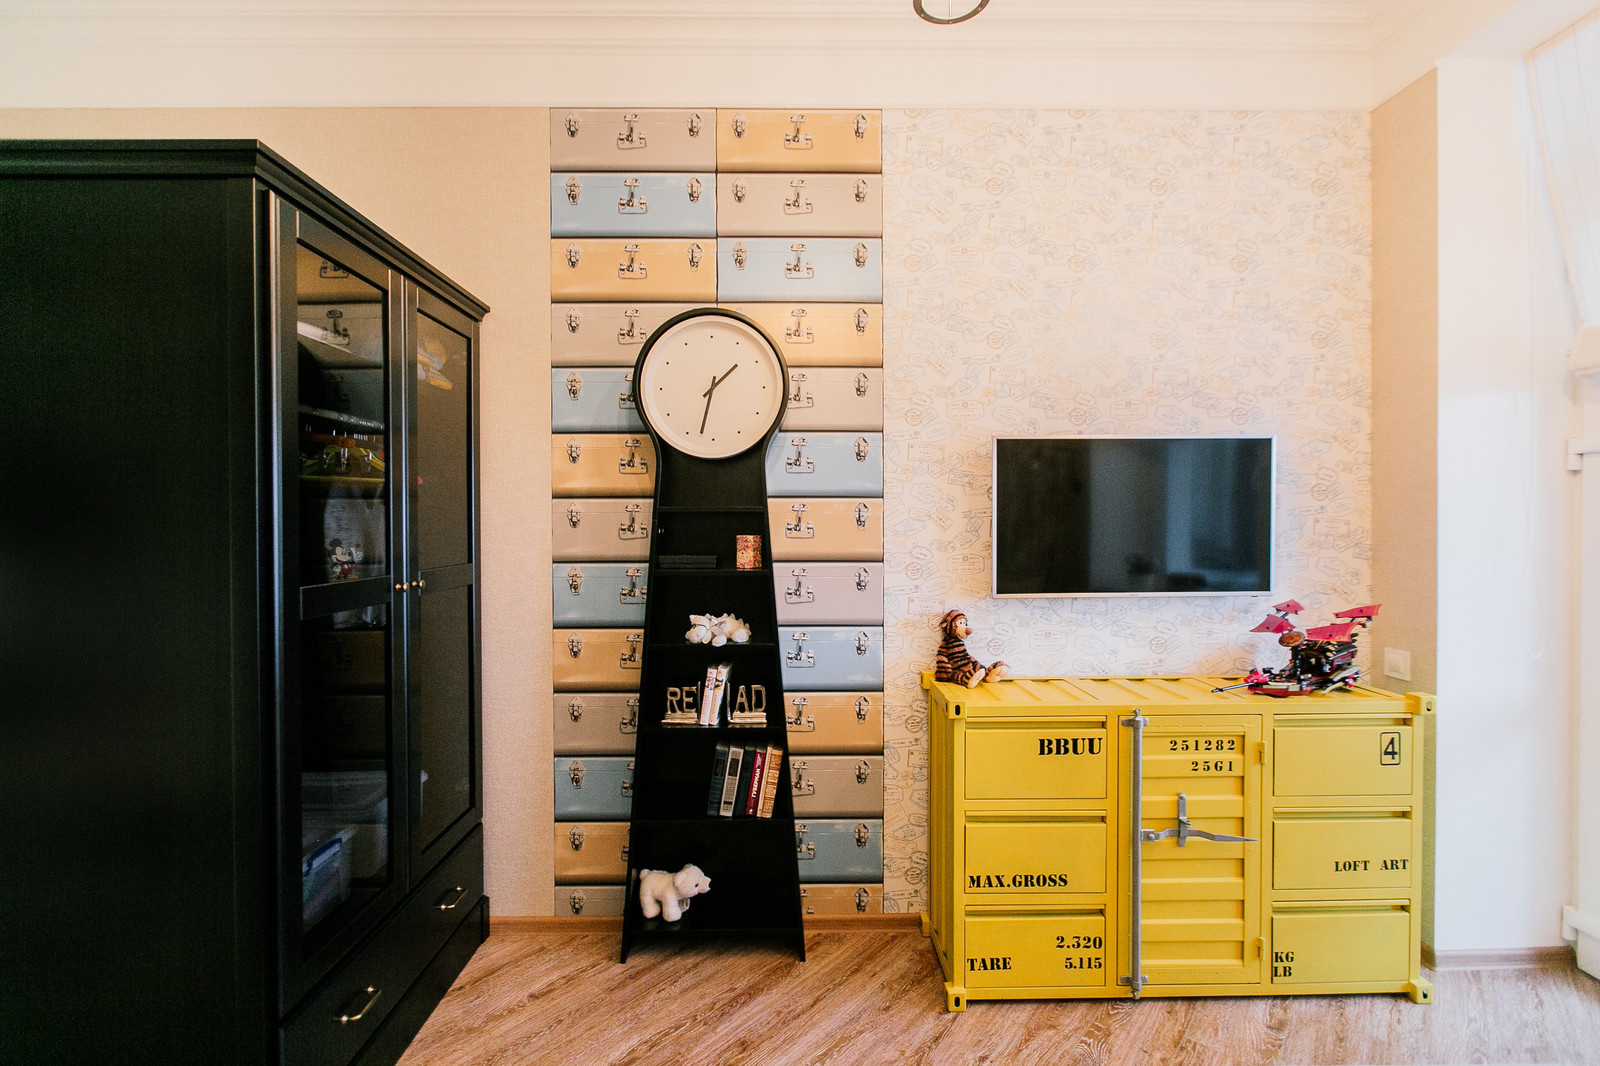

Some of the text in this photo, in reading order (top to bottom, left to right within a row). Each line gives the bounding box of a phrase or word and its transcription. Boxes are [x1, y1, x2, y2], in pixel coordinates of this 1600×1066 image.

[1038, 737, 1103, 756] BBUU
[1169, 739, 1236, 752] 251282
[1383, 736, 1399, 760] 4
[1191, 760, 1234, 772] 25G1
[1334, 859, 1409, 872] LOFT ART
[968, 873, 1068, 889] MAX.GROSS
[1055, 935, 1103, 950] 2.320
[966, 956, 1012, 972] TARE
[1064, 956, 1103, 970] 5.115
[1273, 951, 1295, 963] KG
[1273, 965, 1293, 978] LB
